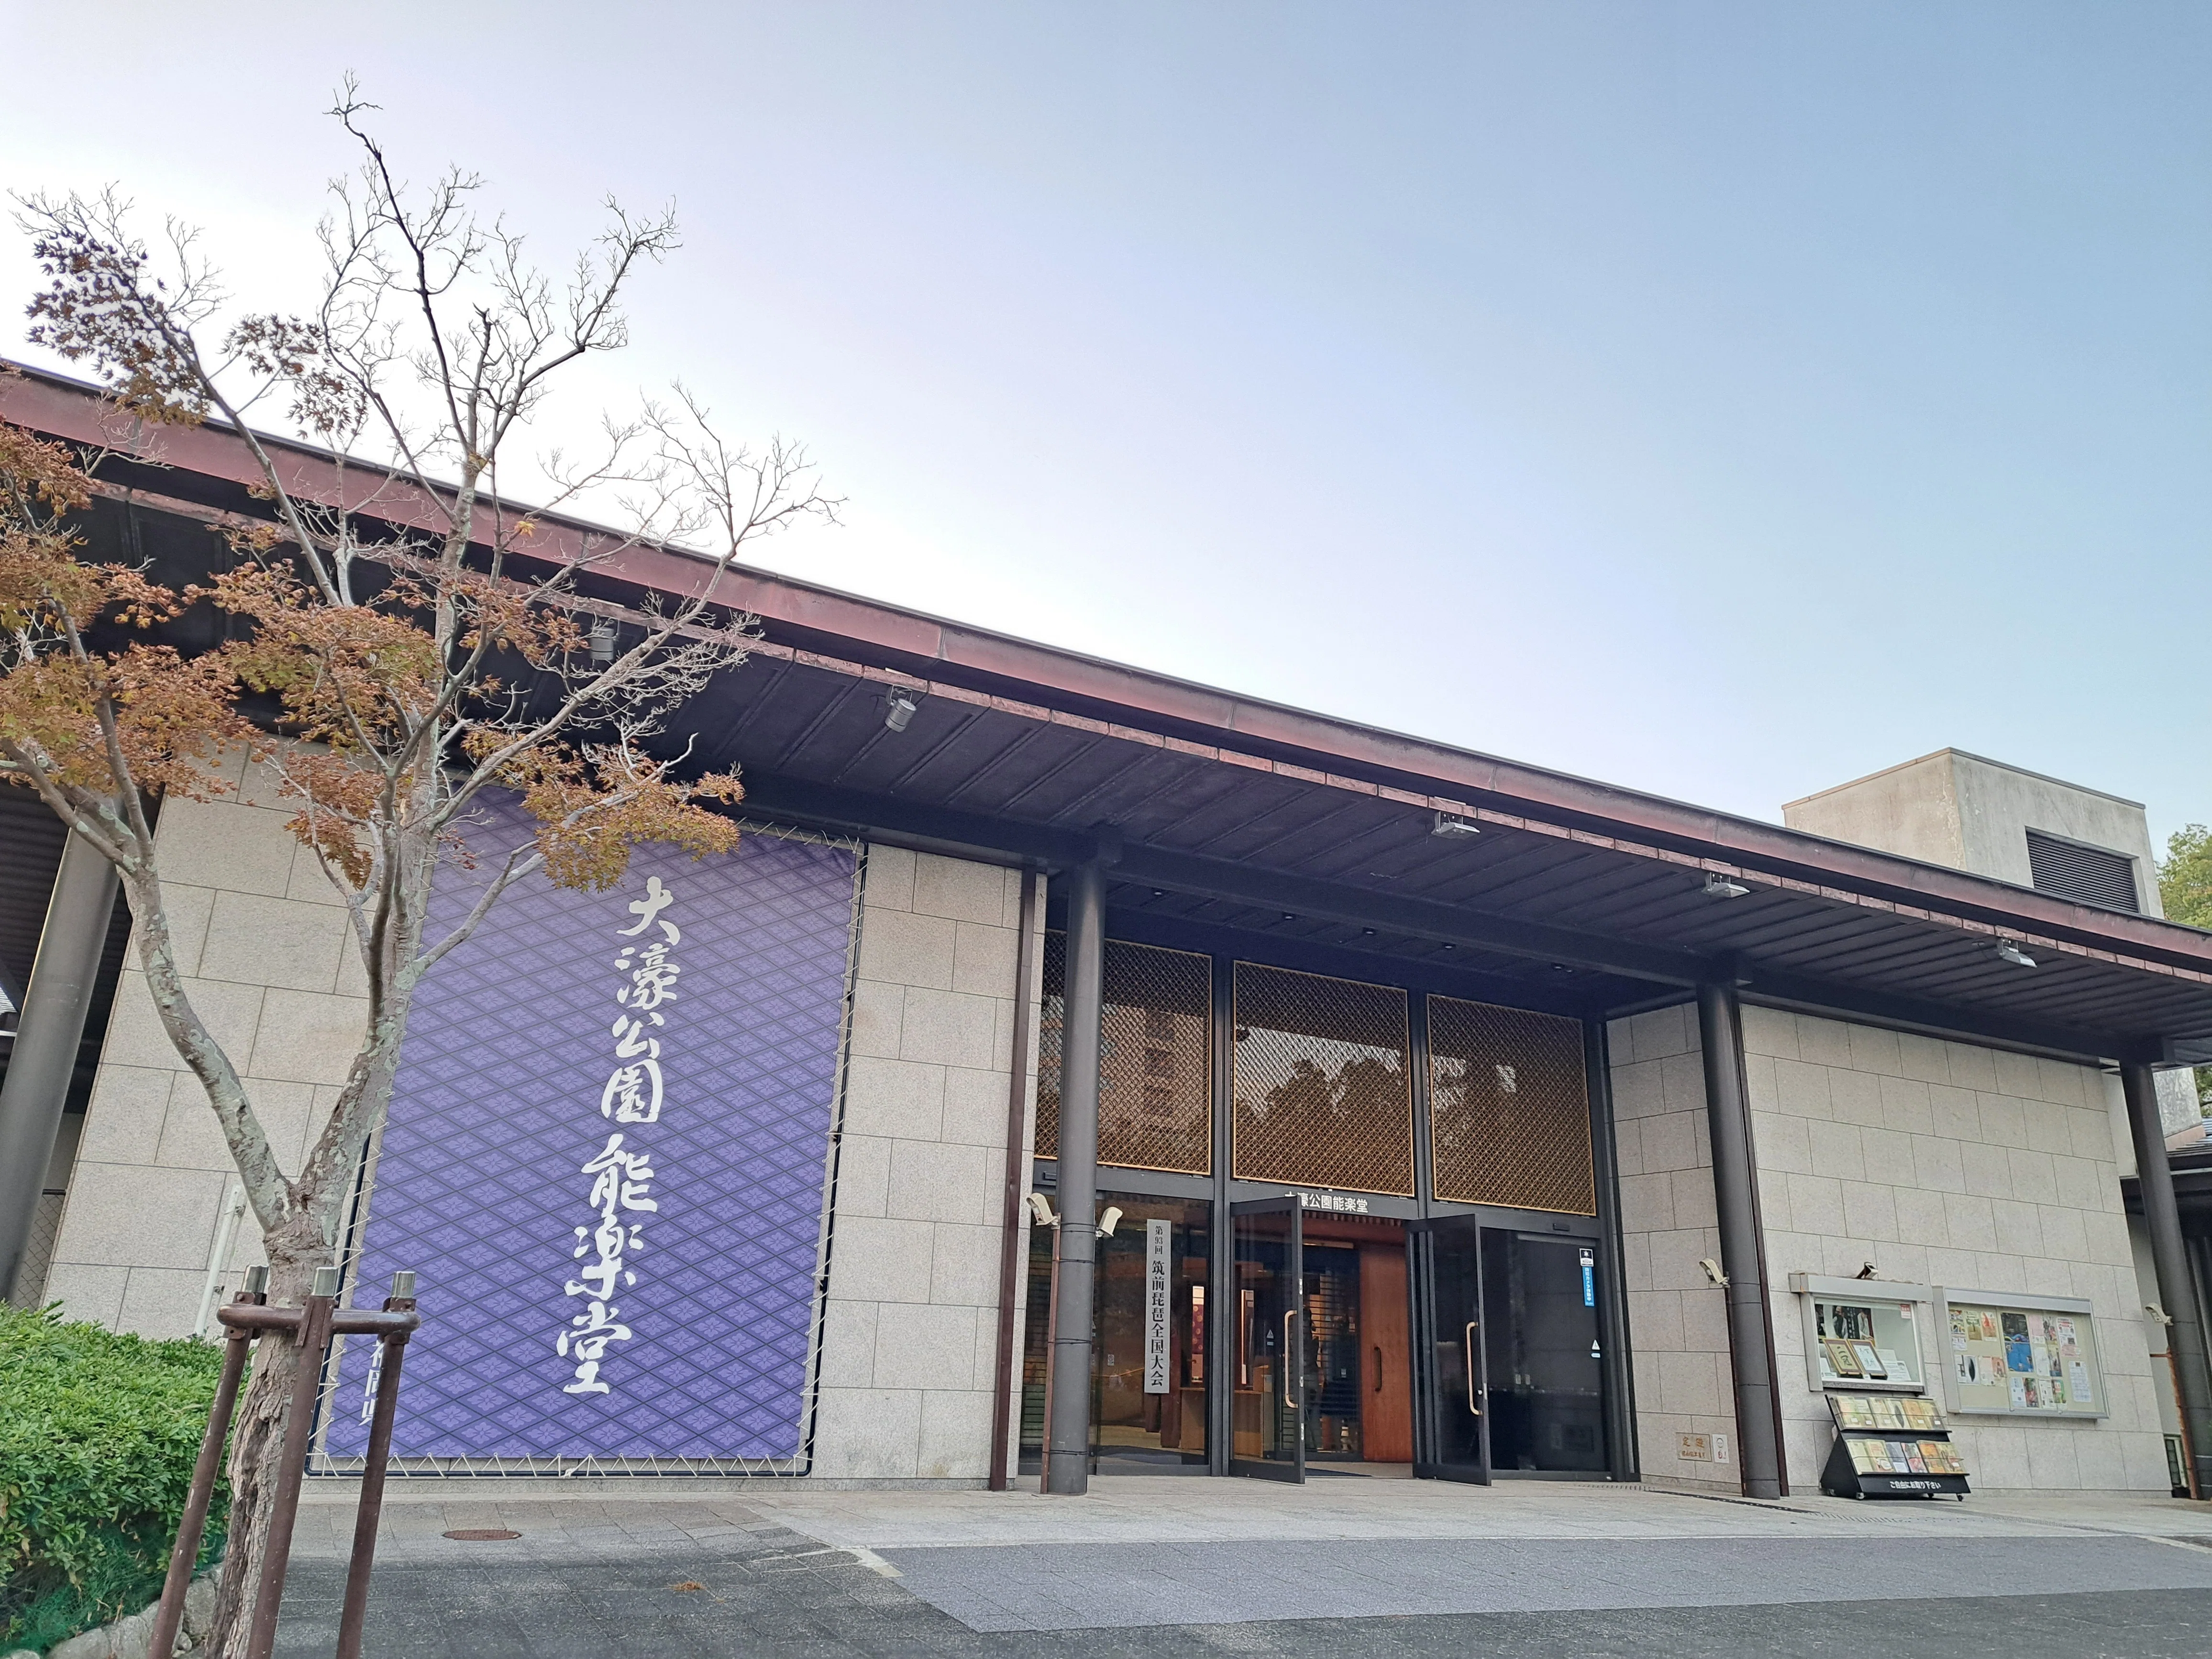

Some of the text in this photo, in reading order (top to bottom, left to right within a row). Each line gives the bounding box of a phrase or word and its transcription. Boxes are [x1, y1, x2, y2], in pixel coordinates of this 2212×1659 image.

[557, 876, 681, 1394] 大濠公園能楽堂
[1150, 1226, 1165, 1386] 第93回 筑前琵琶全国大会
[1890, 1481, 1941, 1489] ご自由にお取り下さい
